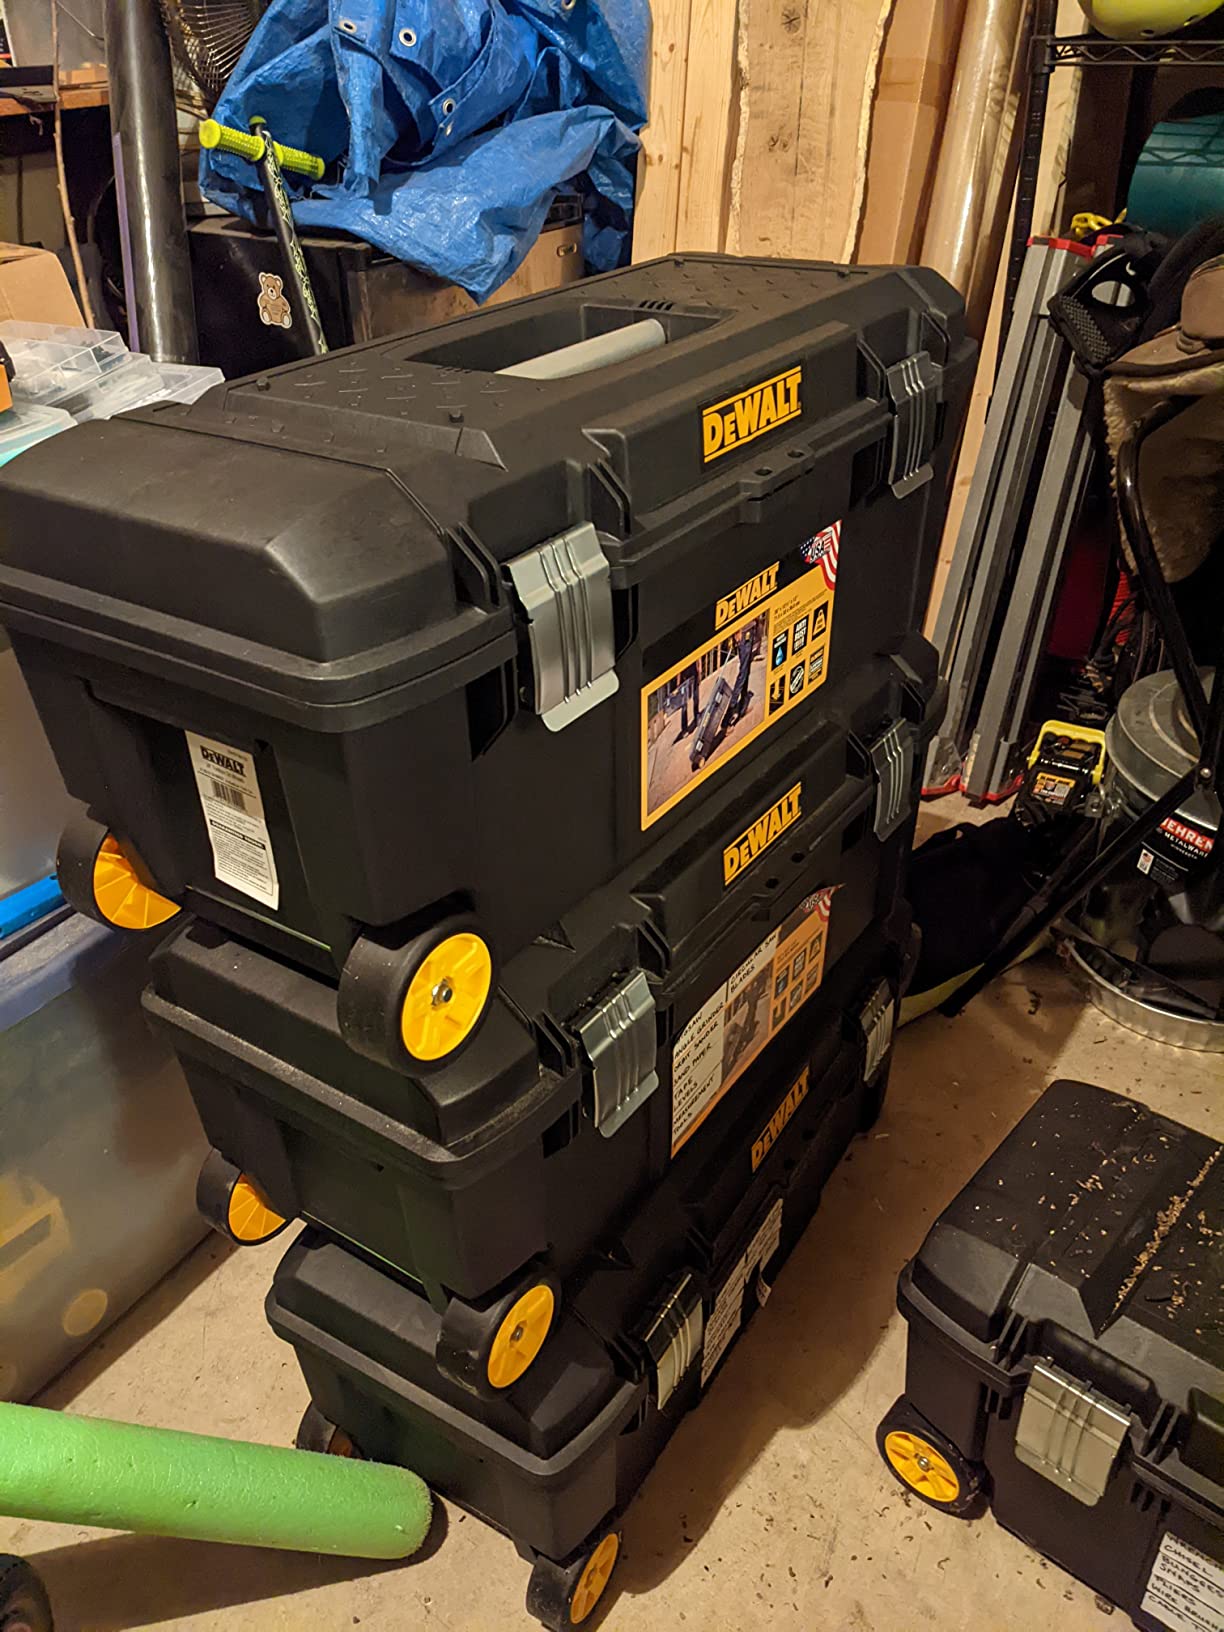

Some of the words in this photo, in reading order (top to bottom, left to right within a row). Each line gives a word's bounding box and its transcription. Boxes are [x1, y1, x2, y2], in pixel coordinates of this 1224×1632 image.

[1161, 817, 1214, 851] EHREN
[764, 934, 776, 949] SAW
[730, 964, 756, 993] BLADES
[674, 1035, 696, 1058] ANGLE
[674, 1052, 691, 1072] ORBIT
[694, 1021, 718, 1052] SANDER
[692, 1042, 712, 1068] PAPER
[674, 1075, 694, 1100] TAPE
[674, 1082, 699, 1111] LEVELS
[1164, 1544, 1213, 1577] CHISEL
[1151, 1583, 1179, 1605] WIRE
[1184, 1605, 1224, 1632] BRUSH
